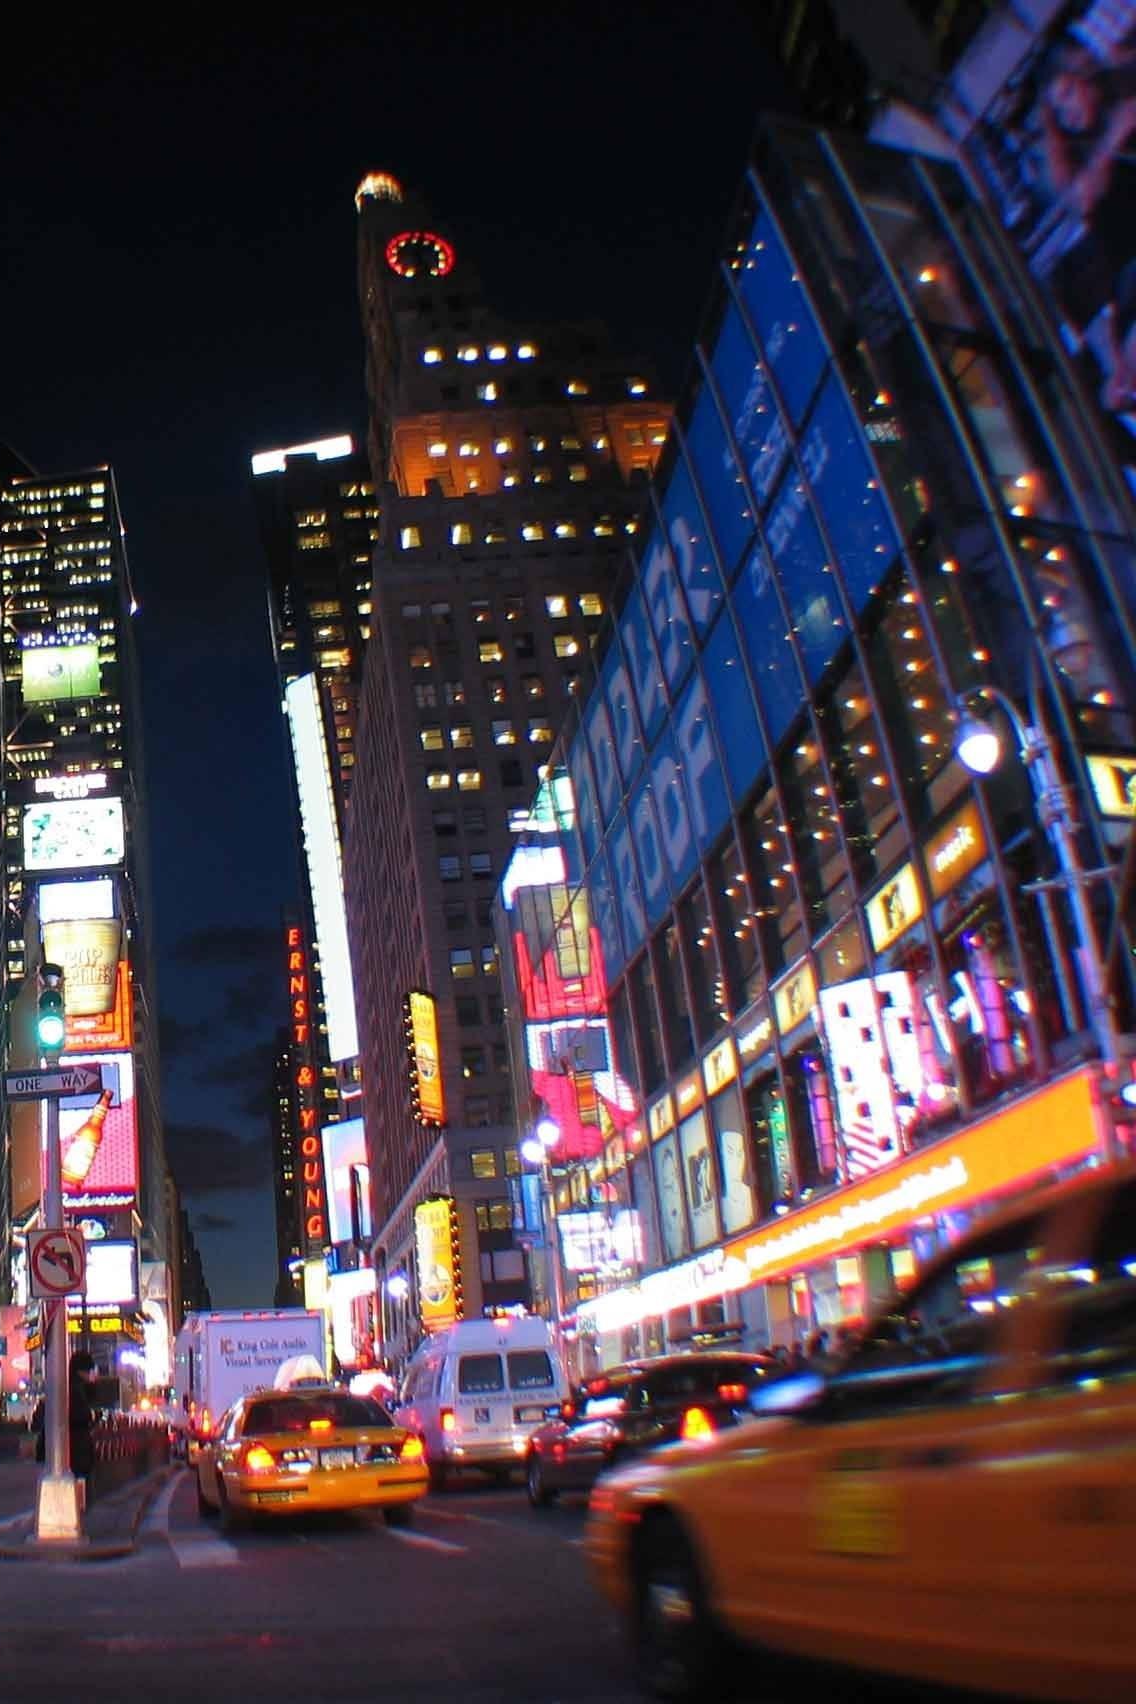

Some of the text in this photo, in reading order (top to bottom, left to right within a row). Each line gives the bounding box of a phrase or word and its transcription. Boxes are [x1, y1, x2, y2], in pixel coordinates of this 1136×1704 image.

[15, 1072, 89, 1092] ONE WAY
[288, 928, 324, 1237] ERNST & YOUNG
[237, 1338, 258, 1352] King
[225, 1356, 251, 1367] Visual
